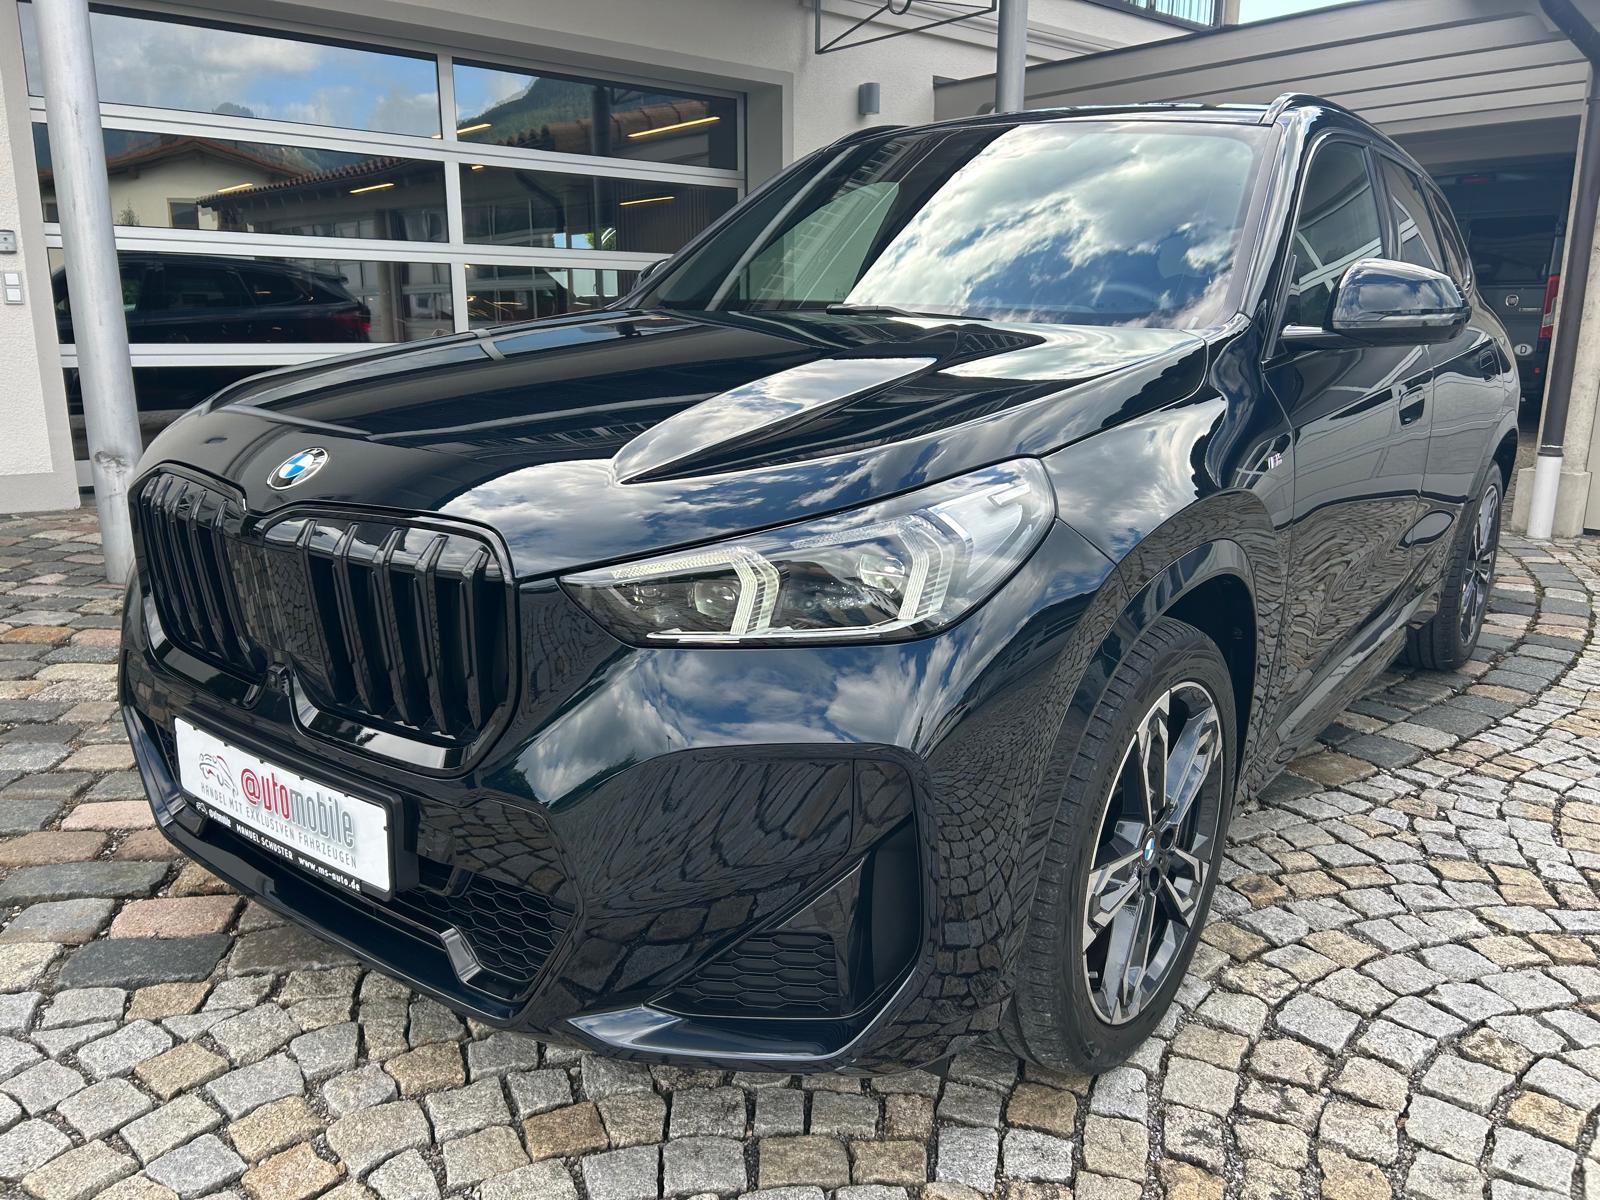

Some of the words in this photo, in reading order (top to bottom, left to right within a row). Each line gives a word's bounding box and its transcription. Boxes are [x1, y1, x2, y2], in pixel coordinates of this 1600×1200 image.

[1520, 345, 1528, 354] D
[201, 783, 227, 806] HANDEL
[228, 796, 242, 813] MIT
[246, 806, 295, 841] EXKLUSIVEN
[298, 831, 357, 869] FAHRZEUGEN
[260, 836, 294, 861] SCHUSTER
[297, 856, 361, 892] www.ms-auto.de
